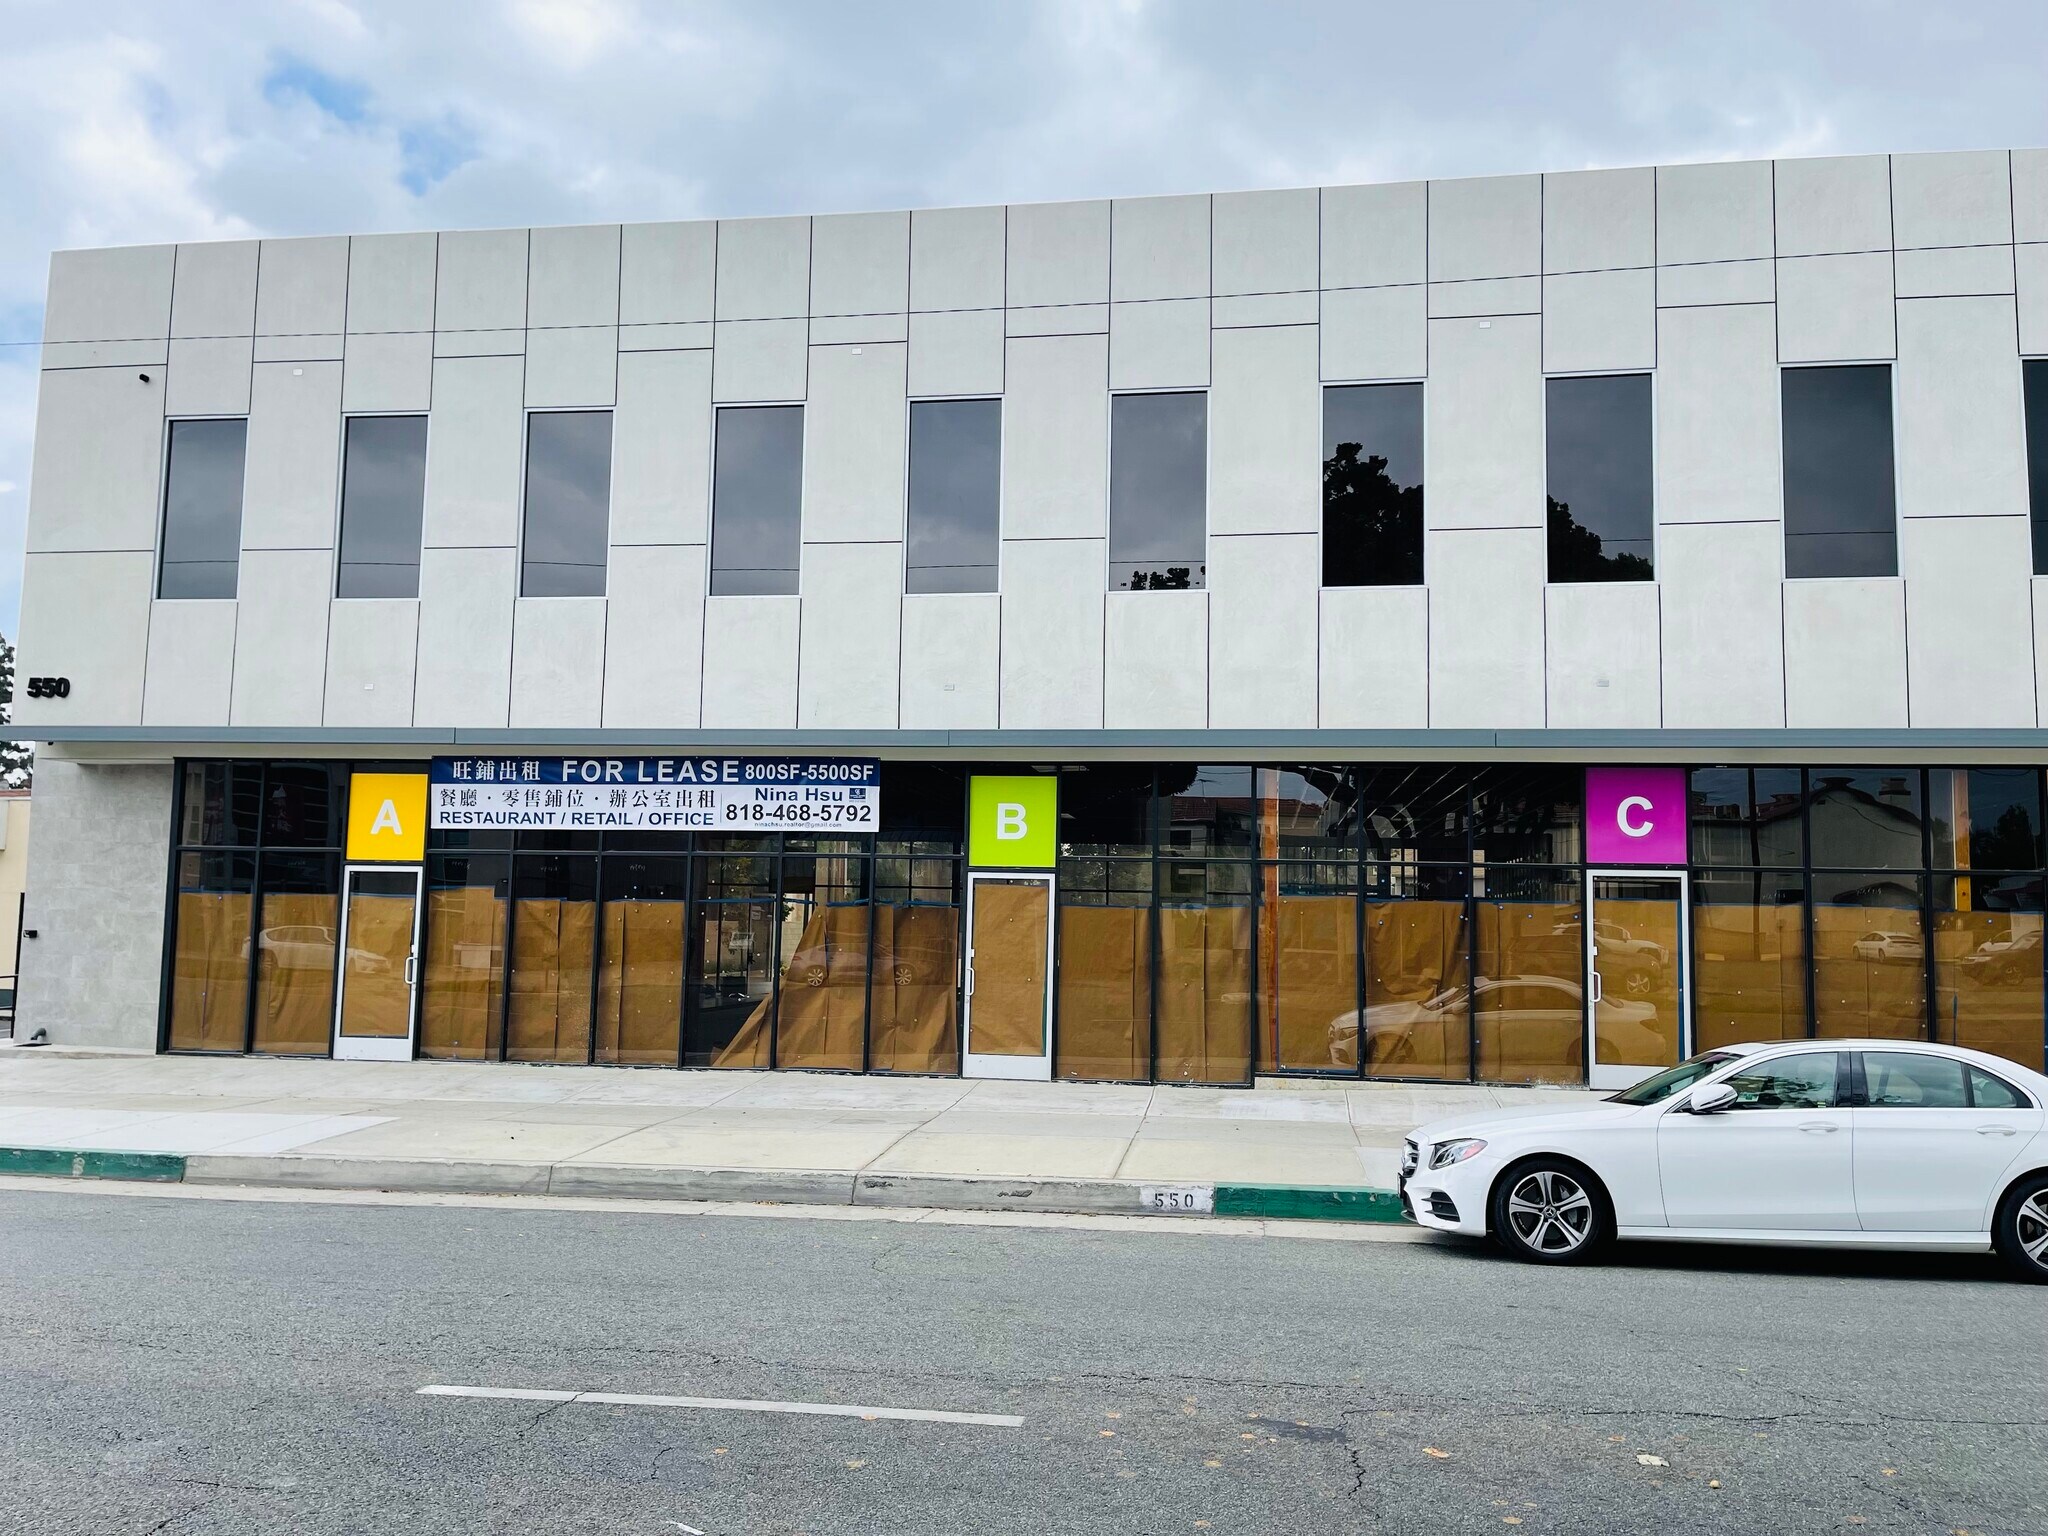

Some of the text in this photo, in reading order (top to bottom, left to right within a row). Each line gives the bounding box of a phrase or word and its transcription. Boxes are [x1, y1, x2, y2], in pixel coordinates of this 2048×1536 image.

[27, 677, 70, 698] 550
[452, 760, 541, 781] 旺鋪出租
[562, 760, 874, 783] FOR LEASE 800SF-5500SF
[755, 787, 843, 802] Nina Hsu
[371, 799, 402, 835] A
[440, 811, 556, 825] RESTAURANT
[571, 812, 633, 825] RETAIL
[648, 812, 714, 826] OFFICE
[725, 803, 871, 822] 818-468-5792
[997, 803, 1028, 840] B
[1617, 796, 1654, 837] C
[1154, 1193, 1194, 1208] 550
